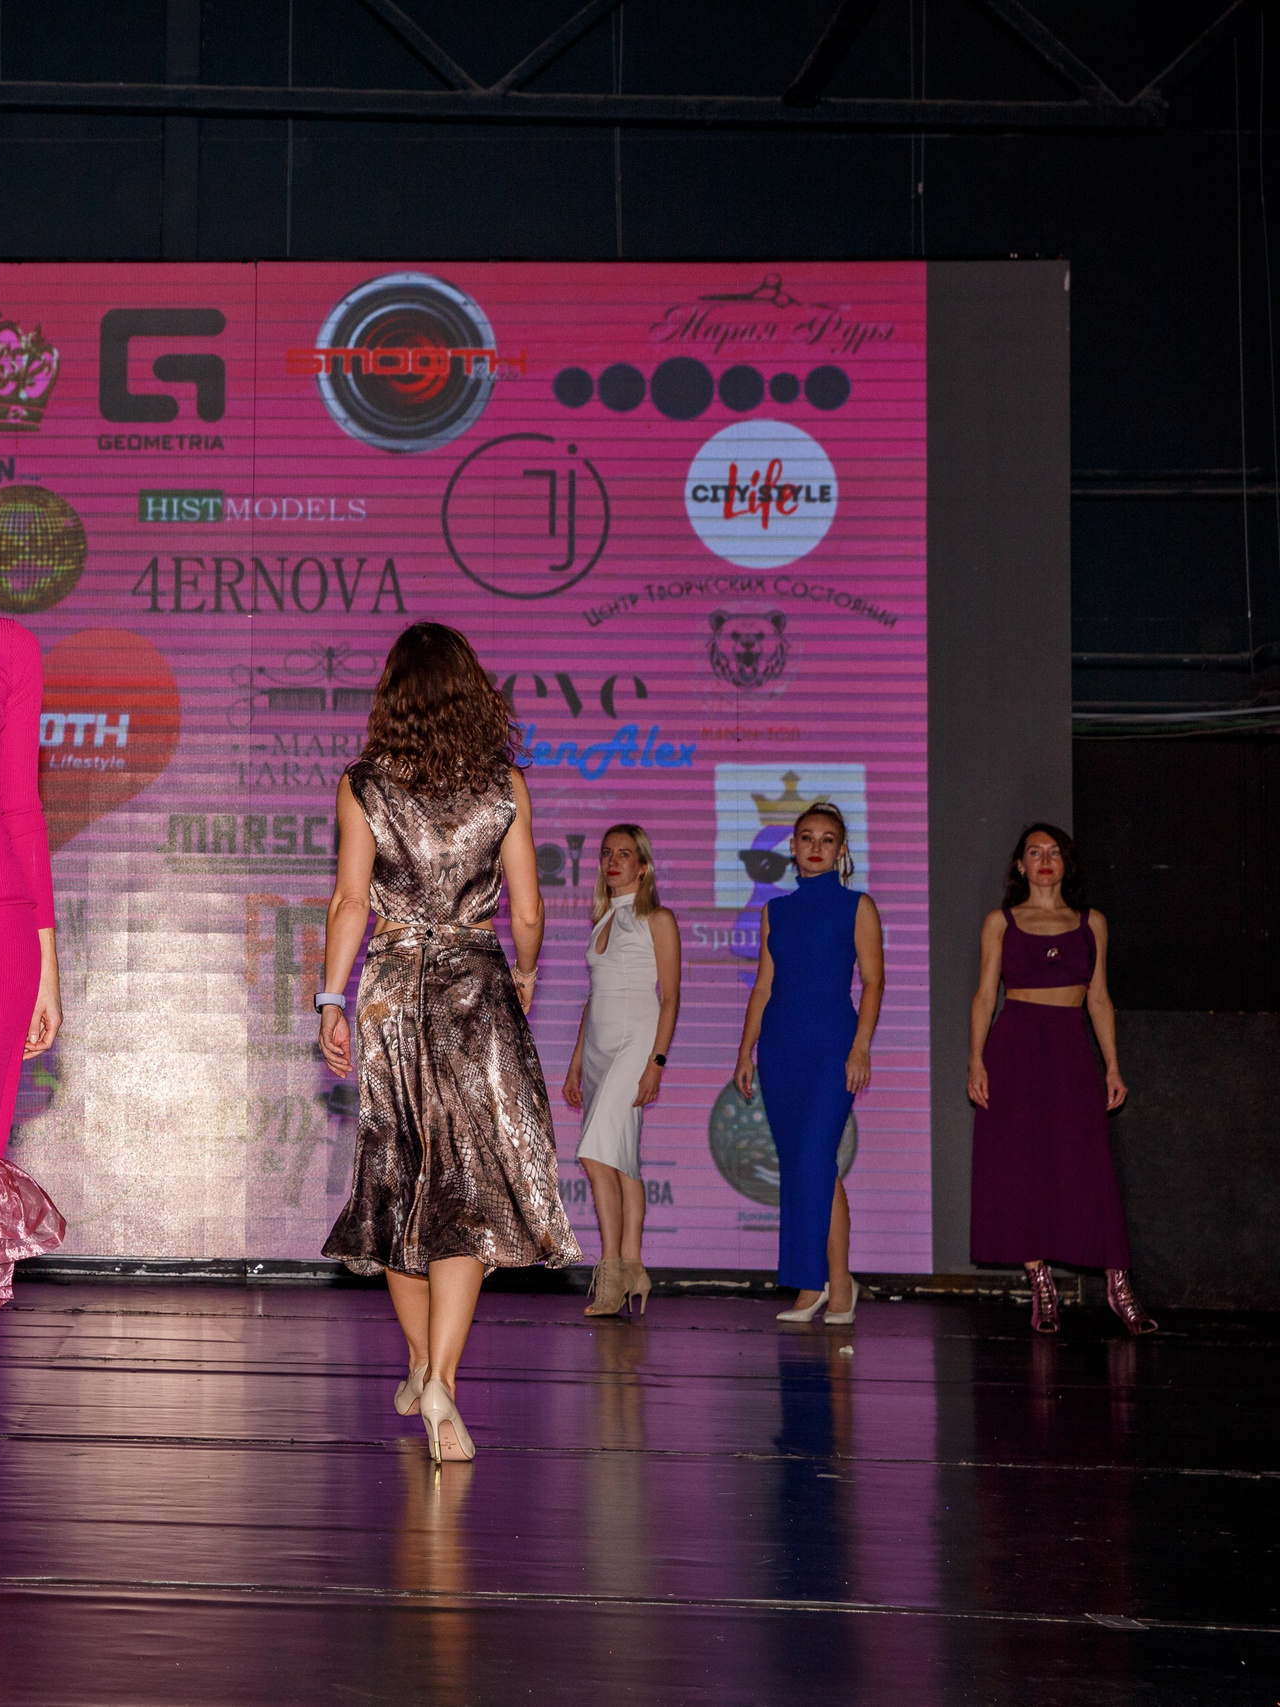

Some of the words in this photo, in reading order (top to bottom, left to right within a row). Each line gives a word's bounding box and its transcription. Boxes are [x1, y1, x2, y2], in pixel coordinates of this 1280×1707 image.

[97, 433, 225, 452] GEOMETRIA
[691, 484, 750, 503] CITY
[757, 484, 832, 503] STYLE
[723, 458, 799, 530] Life
[131, 556, 409, 616] 4ERNOVA
[38, 713, 130, 748] OTH
[49, 754, 126, 771] Lifestyle
[508, 722, 697, 781] lenAlex
[166, 813, 338, 855] MARSC
